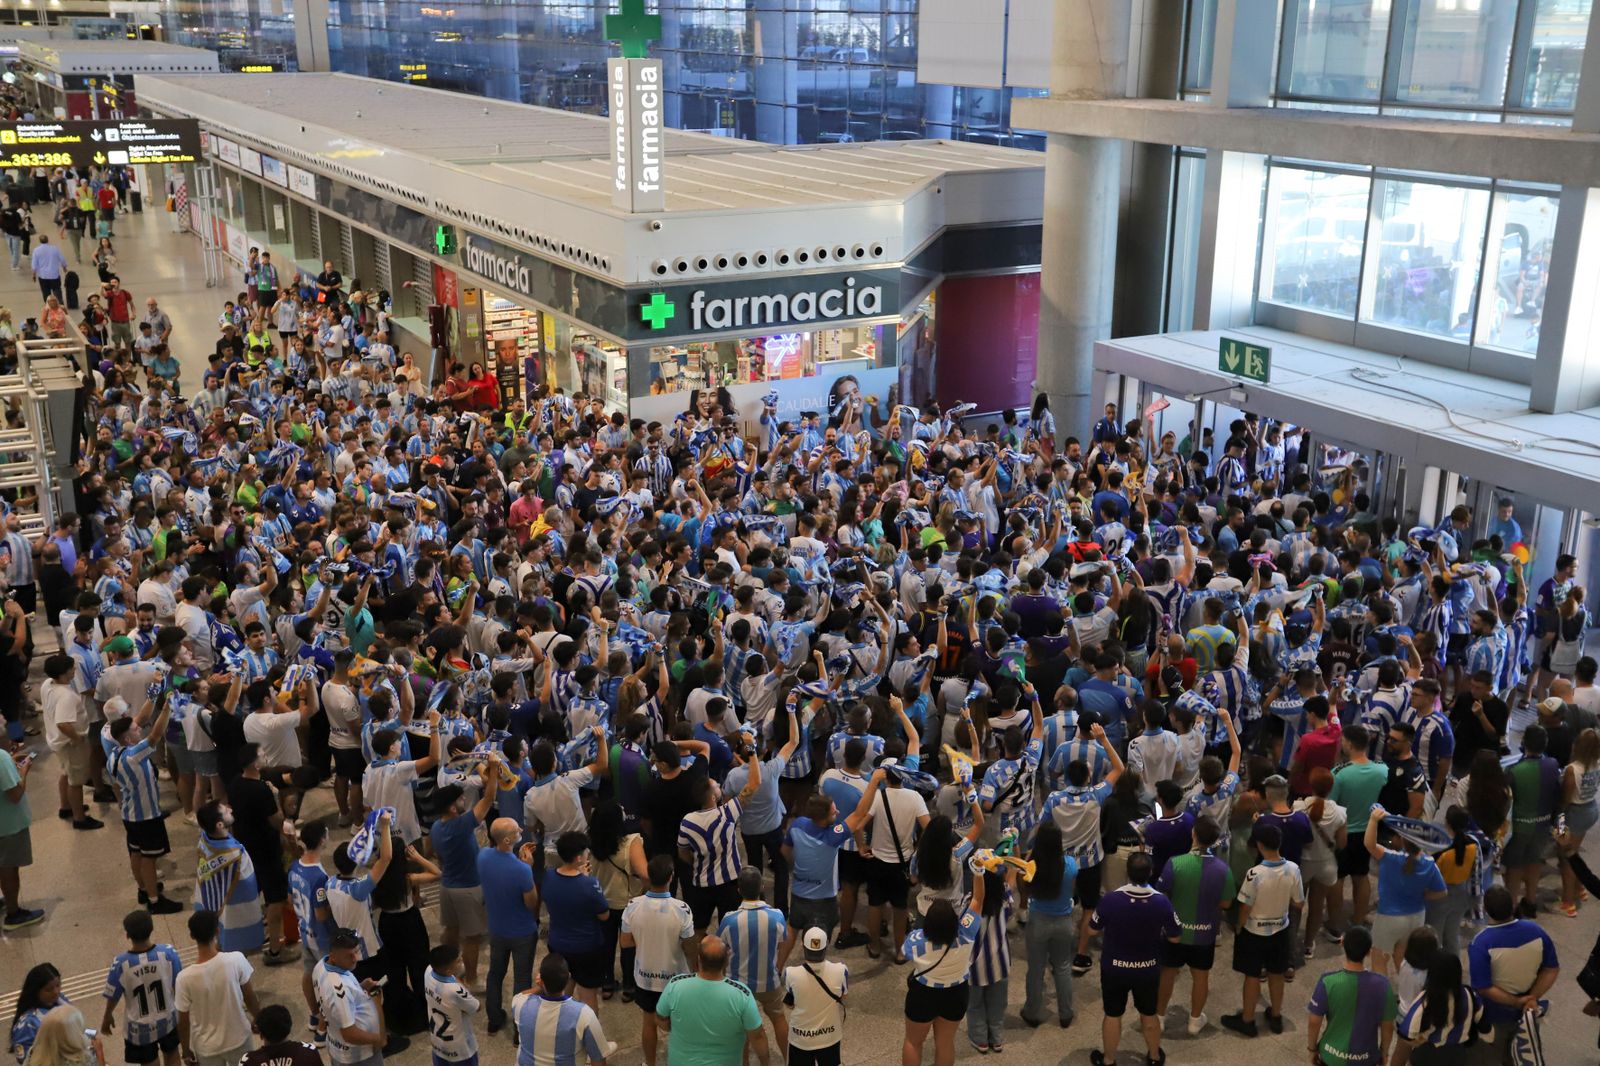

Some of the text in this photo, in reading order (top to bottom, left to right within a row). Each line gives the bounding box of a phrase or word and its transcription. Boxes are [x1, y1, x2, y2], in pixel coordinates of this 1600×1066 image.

[615, 66, 624, 191] farmacia
[635, 66, 658, 193] farmacia
[12, 153, 39, 167] 363
[44, 152, 72, 166] 386
[465, 236, 530, 294] farmacia
[690, 277, 882, 330] farmacia
[134, 965, 157, 977] VISU
[1112, 959, 1156, 969] BENAHAVIS
[133, 980, 167, 1017] 11
[792, 1026, 836, 1037] BENAHAVIS
[1324, 1043, 1369, 1060] BENAHAVIS
